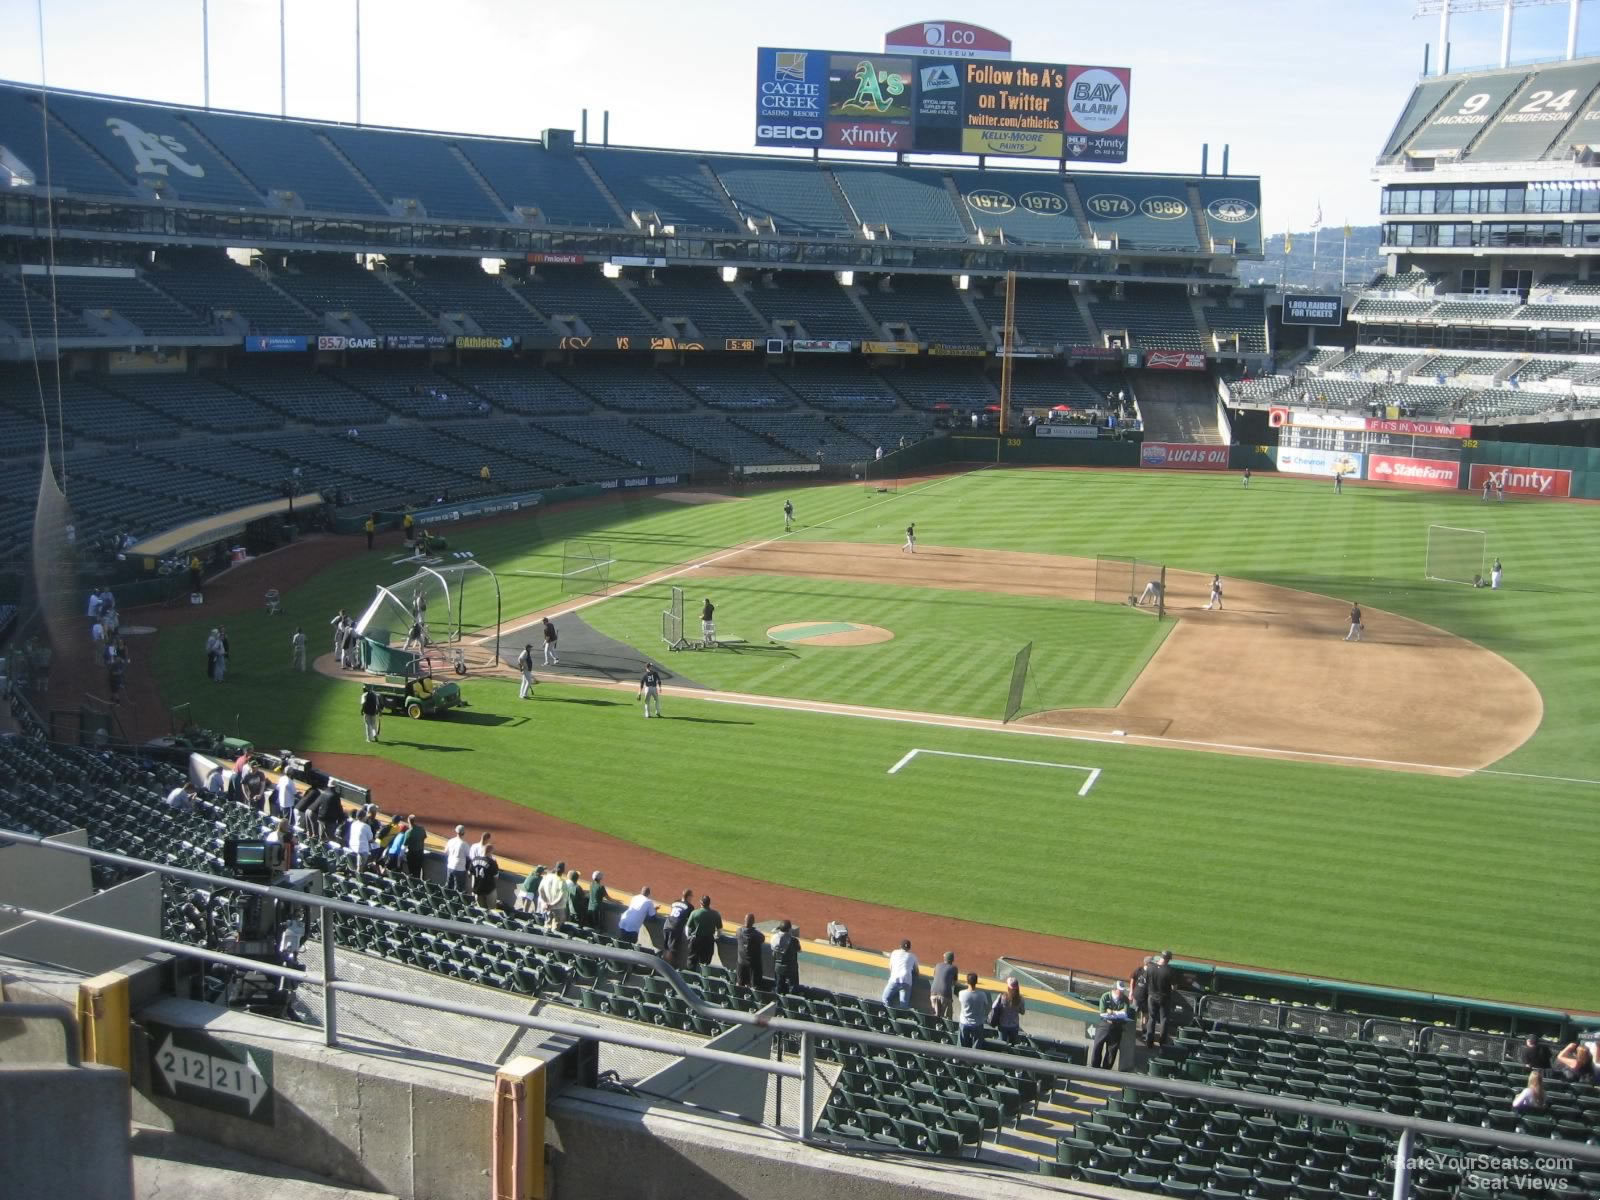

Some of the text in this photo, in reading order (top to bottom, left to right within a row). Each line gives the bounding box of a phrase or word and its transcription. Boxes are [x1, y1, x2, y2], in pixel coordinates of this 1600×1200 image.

[922, 49, 975, 57] COLISEUM
[967, 64, 1064, 88] Follow the A's
[761, 82, 820, 96] CACHE
[841, 60, 905, 112] A's
[1073, 82, 1121, 102] BAY
[761, 95, 820, 109] CREEK
[978, 90, 1050, 112] on Twitter
[1458, 93, 1491, 115] 9
[1518, 89, 1578, 113] 24
[762, 109, 820, 118] CASINO RESORT
[1072, 103, 1119, 115] ALARM
[968, 114, 1060, 129] twitter.com/athletics
[1433, 114, 1489, 125] JACKSON
[1501, 111, 1572, 123] HENDERSON
[757, 125, 823, 140] GEICO
[840, 126, 898, 147] xfinity
[981, 131, 1044, 143] KELLY-MOORE
[999, 142, 1025, 150] PAINTS
[1094, 137, 1125, 149] xfinity
[972, 194, 1011, 208] 1972
[1024, 196, 1063, 210] 1973
[1092, 199, 1130, 212] 1974
[1146, 200, 1183, 214] 1989
[1291, 309, 1333, 318] FOR TICKETS
[319, 337, 345, 349] 95.7
[349, 337, 377, 349] GAME
[456, 336, 503, 348] @Athletics
[616, 337, 629, 349] VS
[1371, 420, 1379, 429] IF
[1381, 421, 1397, 431] IT'S
[1413, 424, 1433, 433] YOU
[1435, 425, 1456, 435] WIN!
[1007, 438, 1021, 446] 330
[1462, 440, 1478, 448] 362
[1167, 448, 1206, 463] LUCAS
[1207, 449, 1226, 463] OIL
[1294, 456, 1326, 466] Chevron
[1488, 469, 1553, 492] xfinity
[163, 1052, 206, 1080] 212
[215, 1066, 257, 1094] 211
